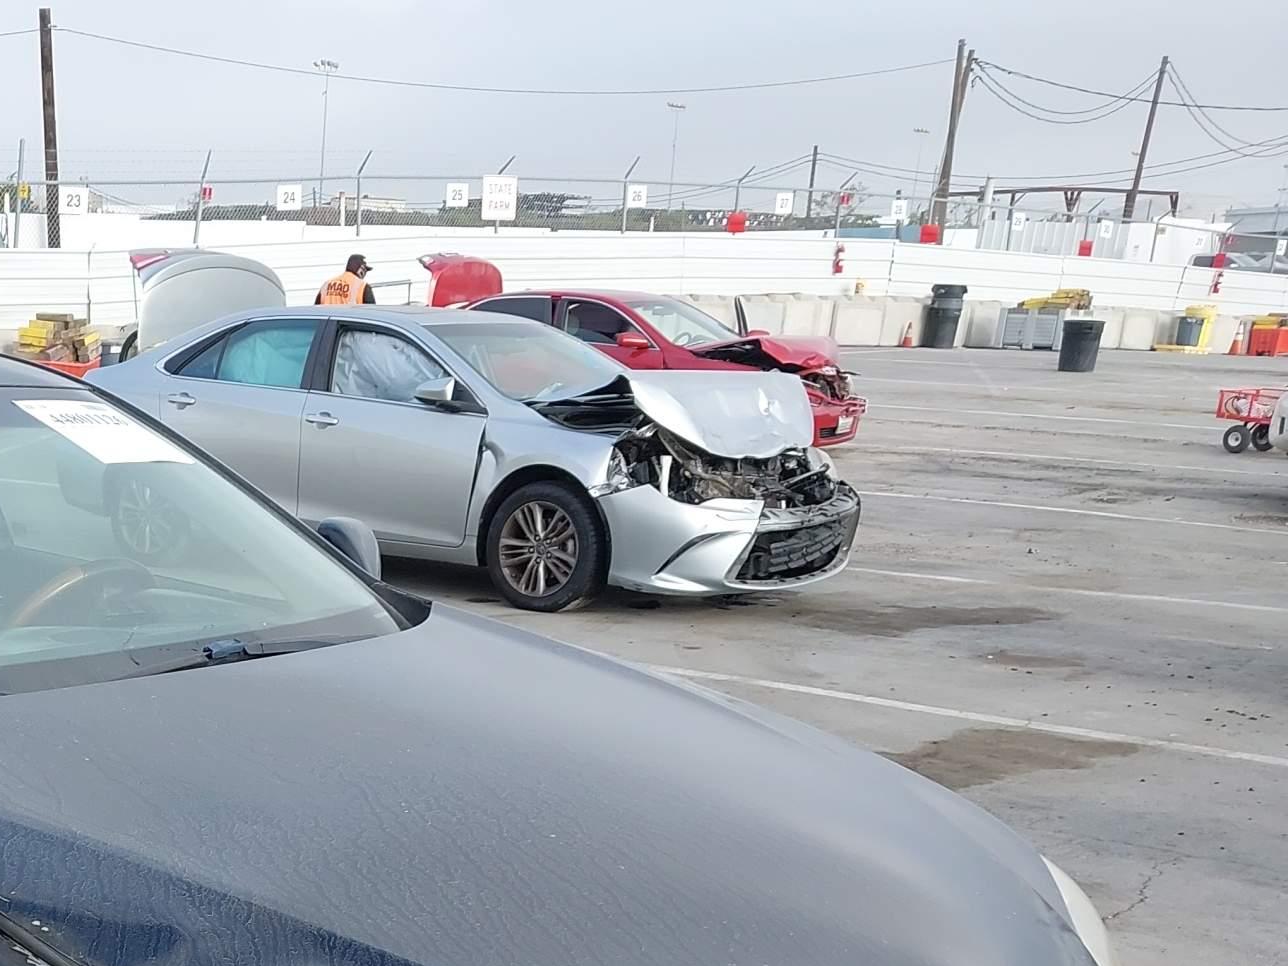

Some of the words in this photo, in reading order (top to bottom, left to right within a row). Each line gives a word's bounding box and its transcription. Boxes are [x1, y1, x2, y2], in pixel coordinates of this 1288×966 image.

[66, 193, 81, 208] 23
[283, 191, 296, 204] 24
[452, 189, 463, 201] 25
[632, 190, 642, 202] 26
[780, 198, 789, 208] 27
